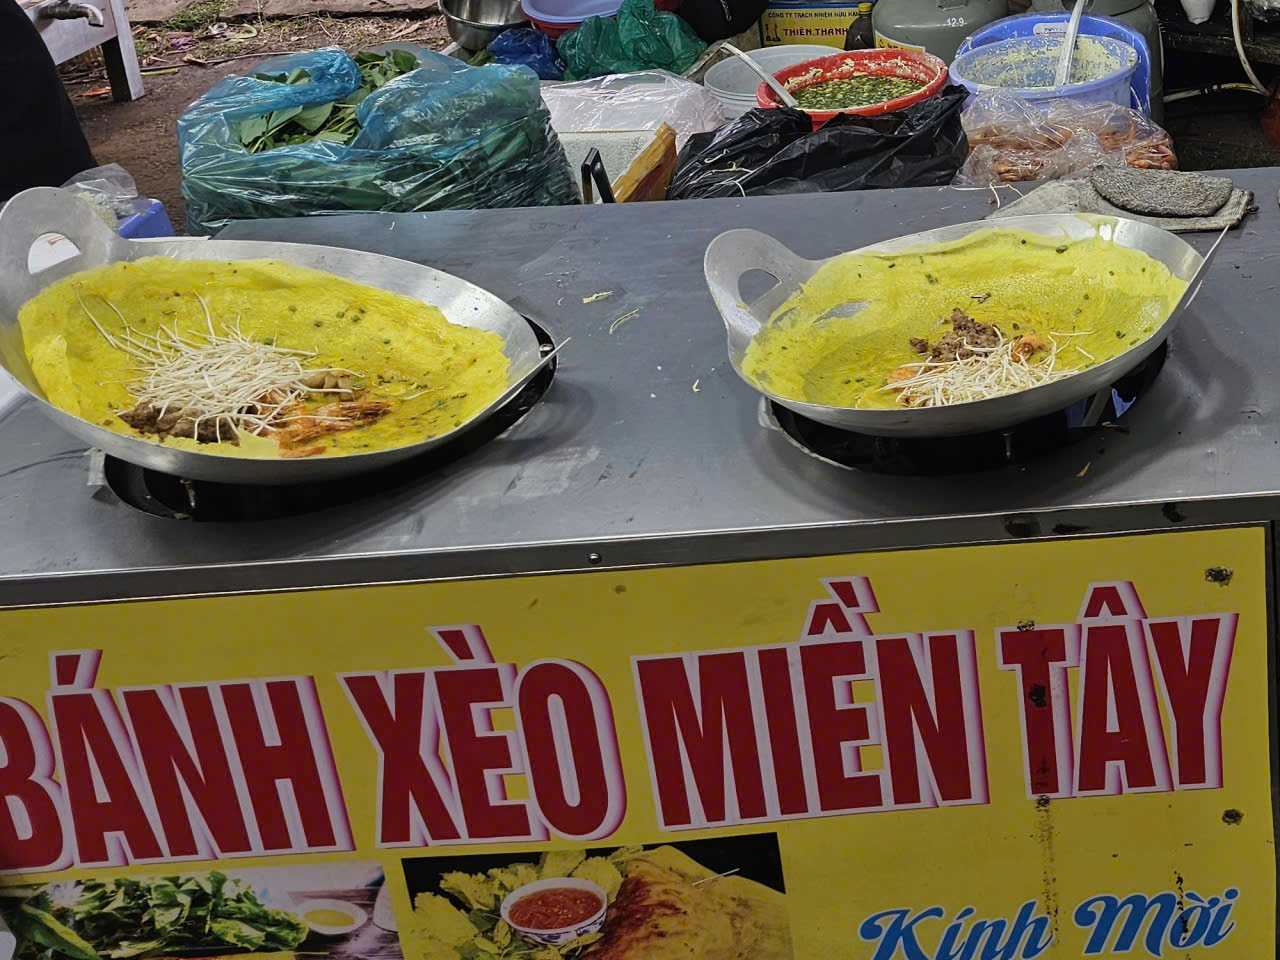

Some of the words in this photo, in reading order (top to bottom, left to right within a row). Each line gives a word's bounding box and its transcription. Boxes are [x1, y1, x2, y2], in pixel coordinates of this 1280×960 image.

[0, 649, 356, 876] BÁNH
[336, 624, 628, 849] XÈO
[631, 576, 991, 832] MIỀN
[994, 581, 1240, 800] TÂY
[857, 898, 1055, 960] Kính
[1073, 887, 1241, 959] Mời
